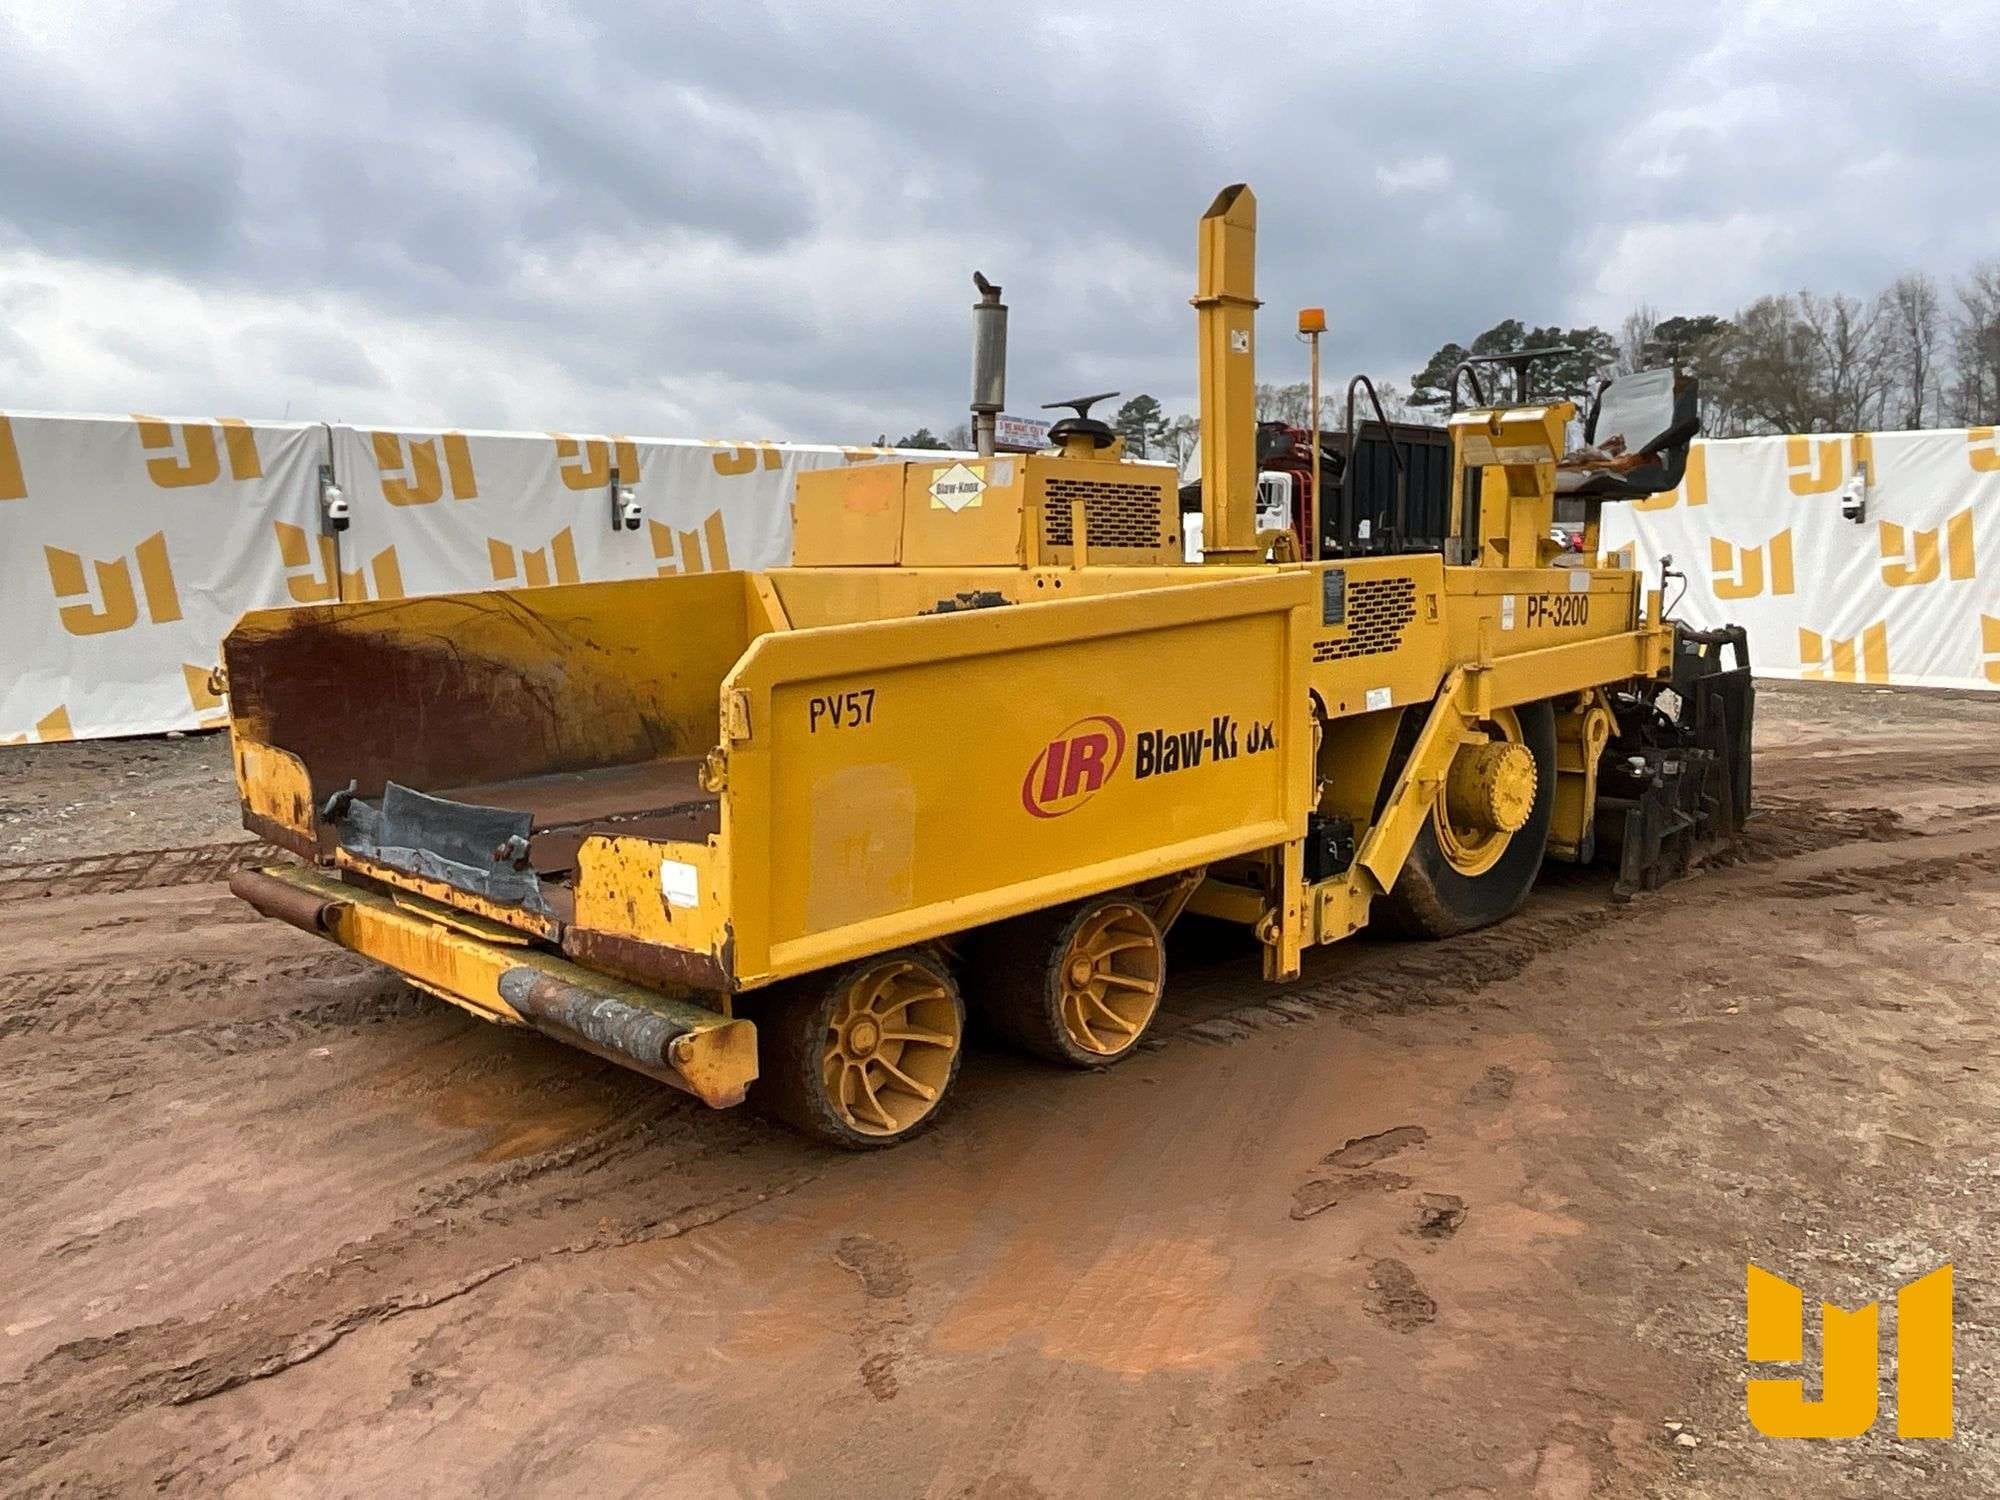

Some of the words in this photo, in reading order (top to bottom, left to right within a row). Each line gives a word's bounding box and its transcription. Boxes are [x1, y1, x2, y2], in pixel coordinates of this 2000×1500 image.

[1526, 593, 1589, 629] PF-3200
[809, 688, 875, 734] PV57
[1039, 732, 1109, 803] IR
